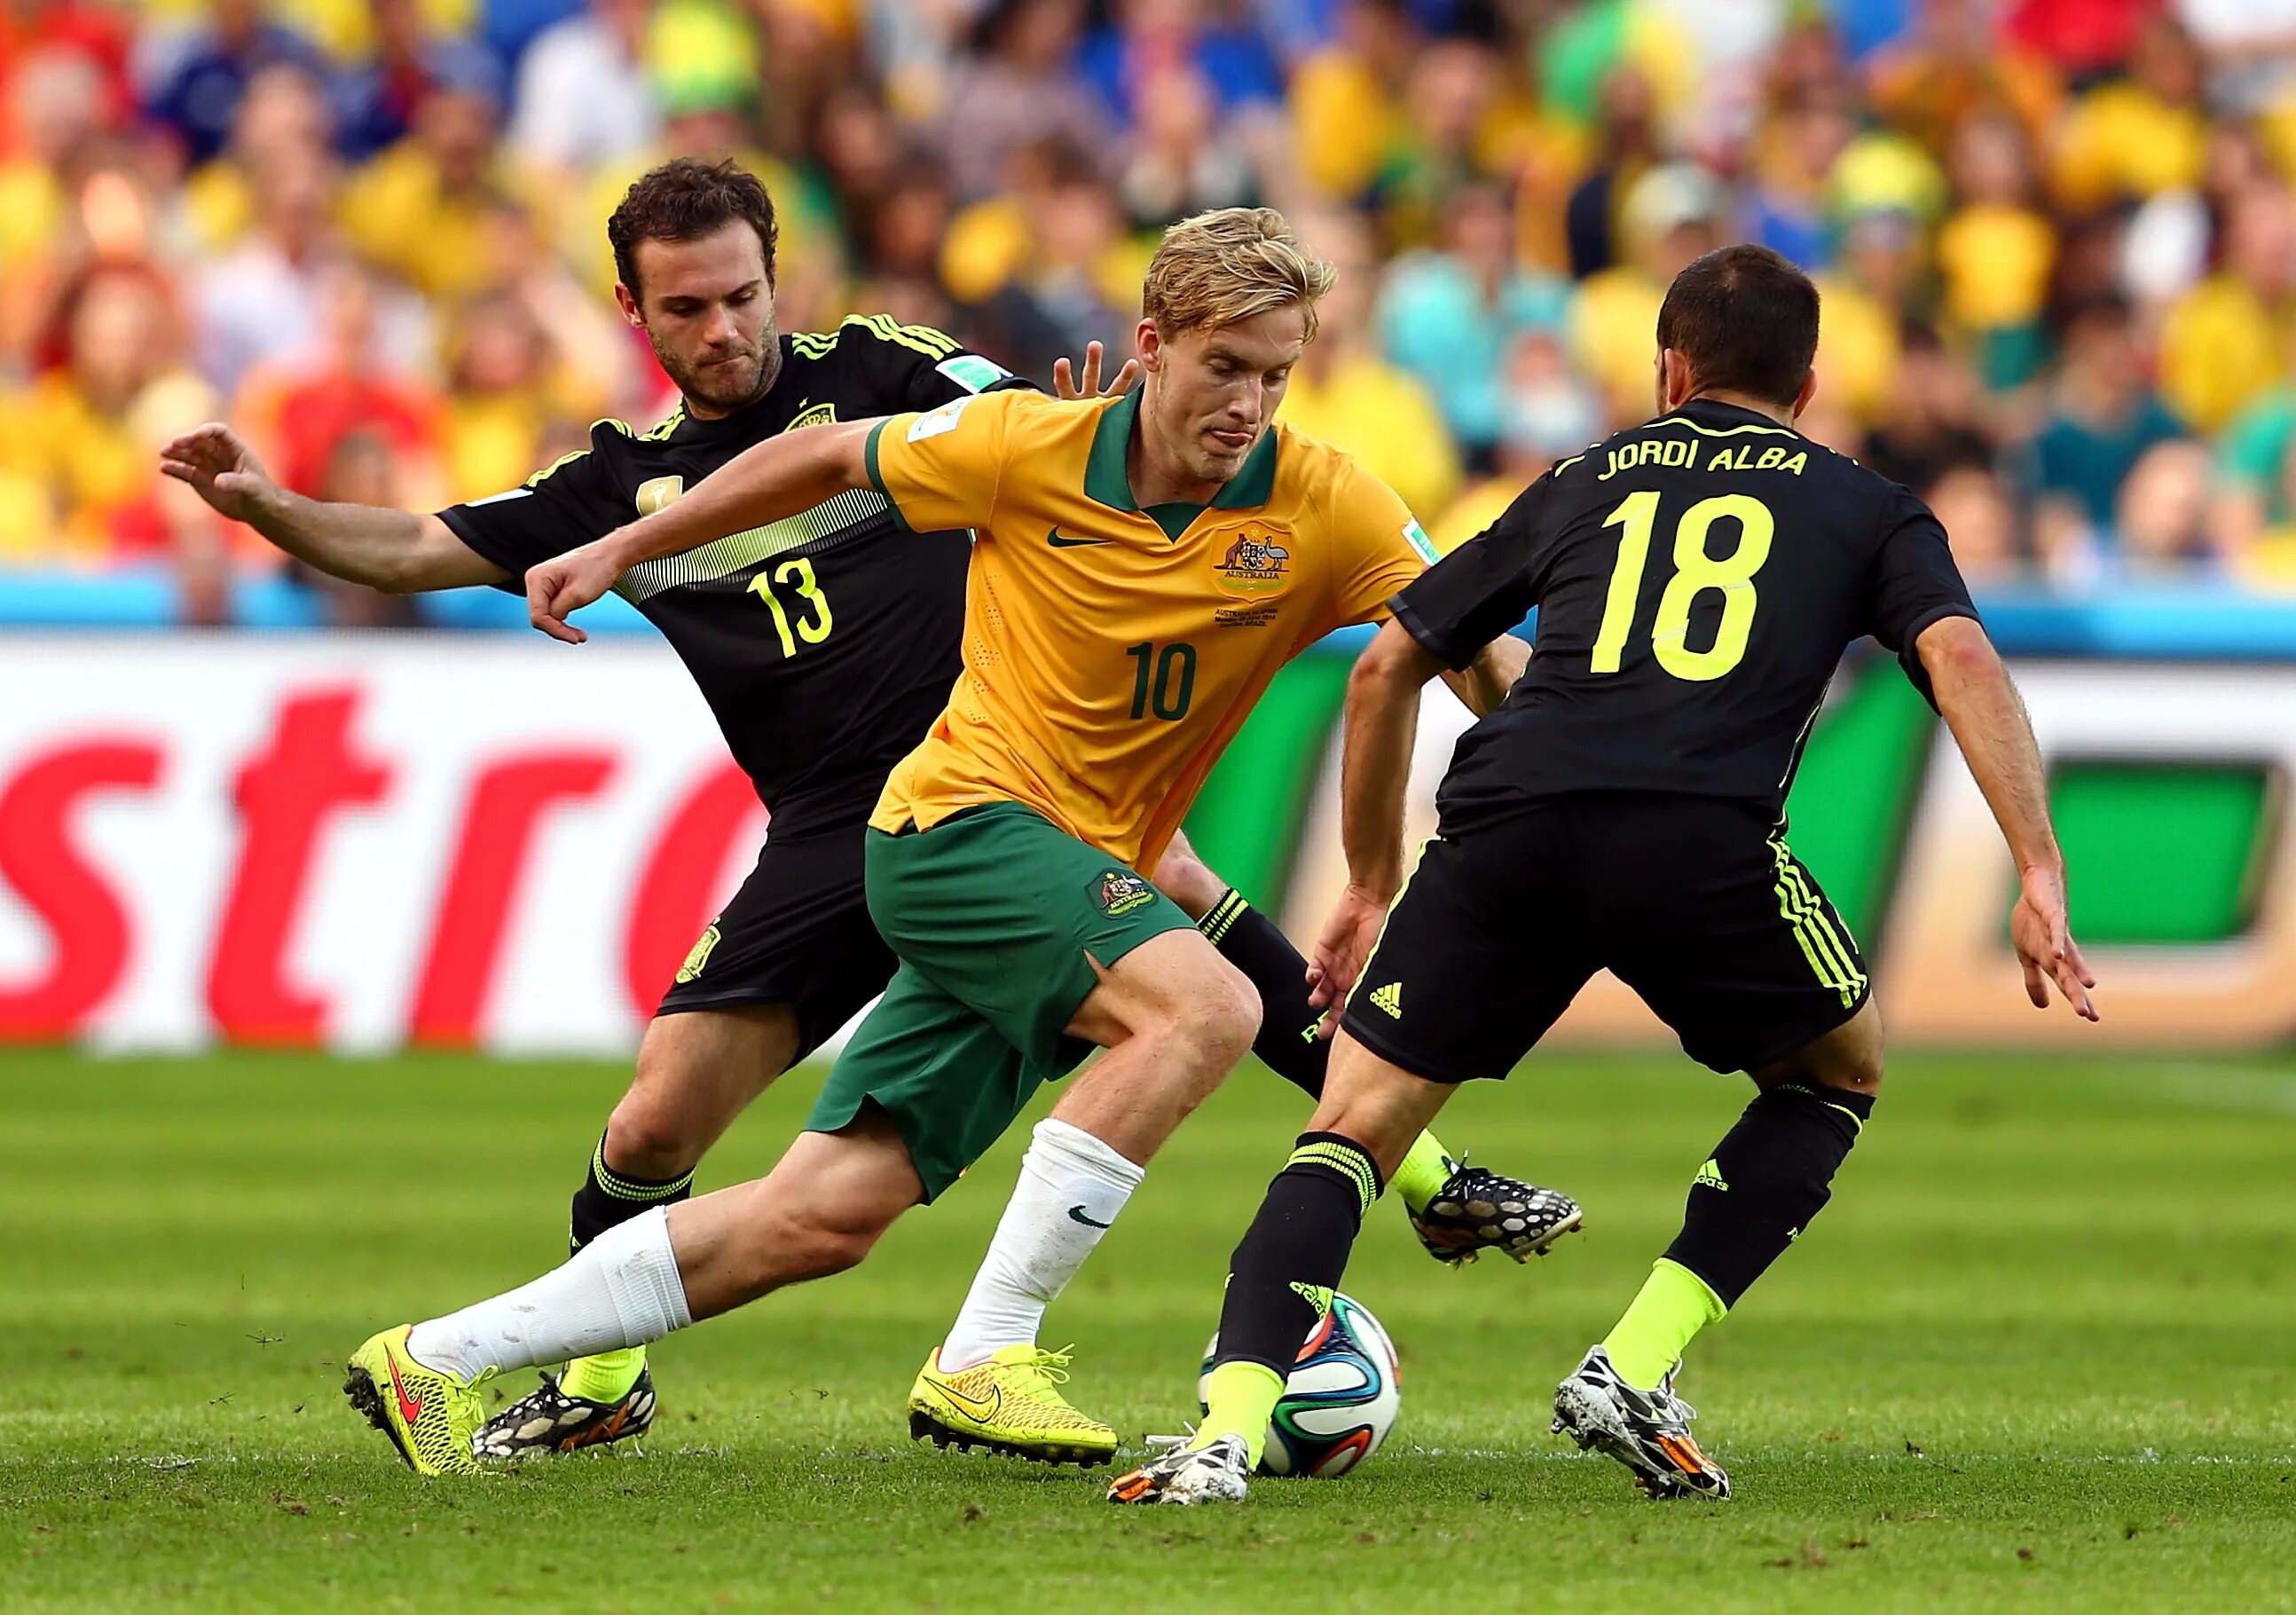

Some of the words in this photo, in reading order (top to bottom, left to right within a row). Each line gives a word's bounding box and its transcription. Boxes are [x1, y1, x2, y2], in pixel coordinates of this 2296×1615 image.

[1598, 439, 1699, 480] JORDI
[1708, 445, 1807, 476] ALBA
[1224, 571, 1280, 580] AUSTRALIA
[1590, 491, 1774, 681] 18
[746, 557, 832, 658] 13
[1127, 642, 1196, 721] 10
[1369, 991, 1402, 1020] adidas
